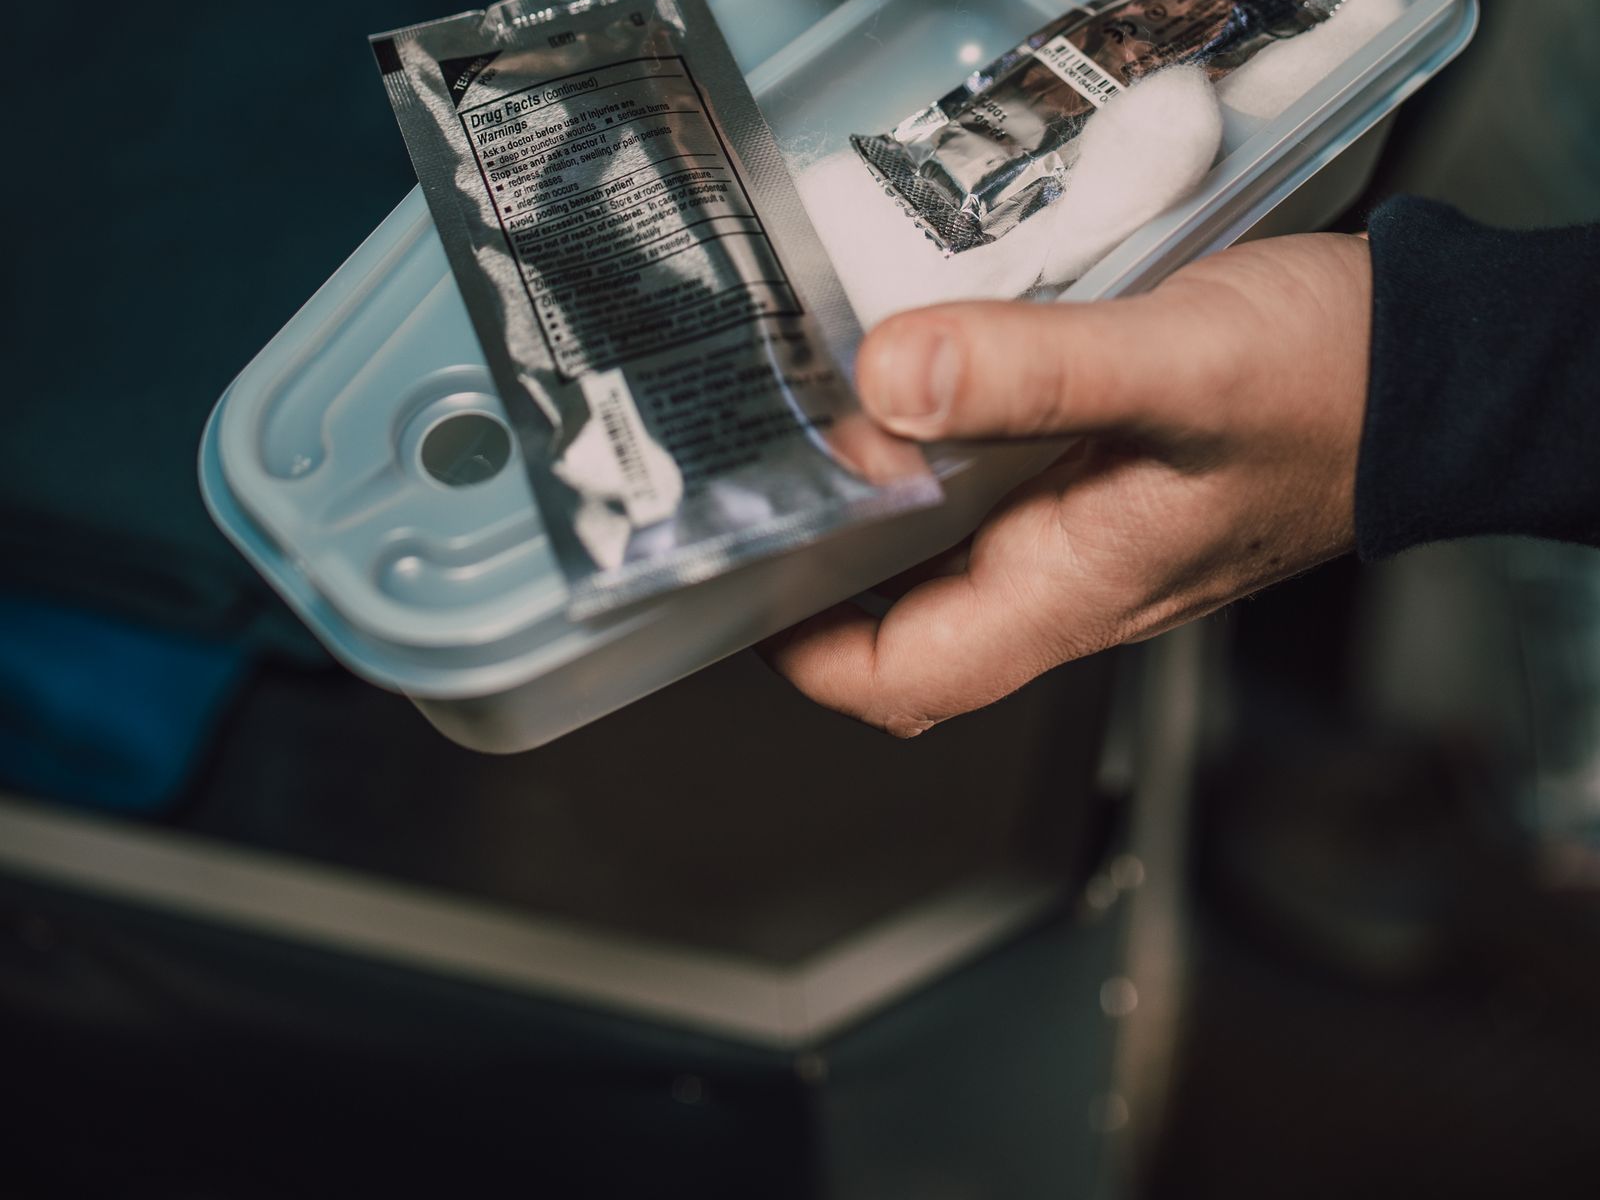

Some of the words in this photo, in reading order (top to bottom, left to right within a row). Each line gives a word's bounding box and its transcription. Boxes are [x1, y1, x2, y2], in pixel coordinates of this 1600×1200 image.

[470, 108, 502, 128] Drug
[504, 94, 540, 115] Facts
[542, 76, 599, 103] (continued)
[477, 120, 527, 145] Warnings
[483, 147, 499, 159] Ask
[507, 134, 533, 149] doctor
[534, 123, 562, 138] before
[563, 116, 579, 127] use
[586, 103, 619, 118] injuries
[499, 151, 519, 163] deep
[530, 134, 564, 153] puncture
[565, 122, 596, 138] wounds
[617, 107, 646, 120] serious
[508, 170, 543, 187] redness,
[542, 158, 579, 174] irritation,
[579, 146, 612, 162] swelling
[622, 135, 640, 149] pain
[640, 126, 671, 142] persists
[490, 169, 511, 182] Stop
[511, 163, 528, 173] use
[529, 155, 545, 167] and
[546, 149, 562, 161] ask
[570, 138, 597, 152] doctor
[524, 175, 562, 192] increases
[510, 214, 534, 229] Avoid
[535, 203, 568, 222] pooling
[568, 189, 603, 208] beneath
[604, 177, 634, 197] patient
[514, 228, 540, 242] Avoid
[541, 214, 583, 234] excessive
[584, 205, 607, 218] heat.
[609, 196, 632, 209] Store
[642, 182, 663, 196] room
[663, 171, 713, 187] temperature.
[515, 191, 550, 209] infection
[551, 182, 579, 197] occurs
[543, 238, 559, 248] out
[571, 226, 595, 240] reach
[596, 221, 606, 231] of
[607, 208, 644, 227] children.
[657, 193, 677, 206] case
[687, 181, 728, 195] accidental
[688, 194, 717, 207] consult
